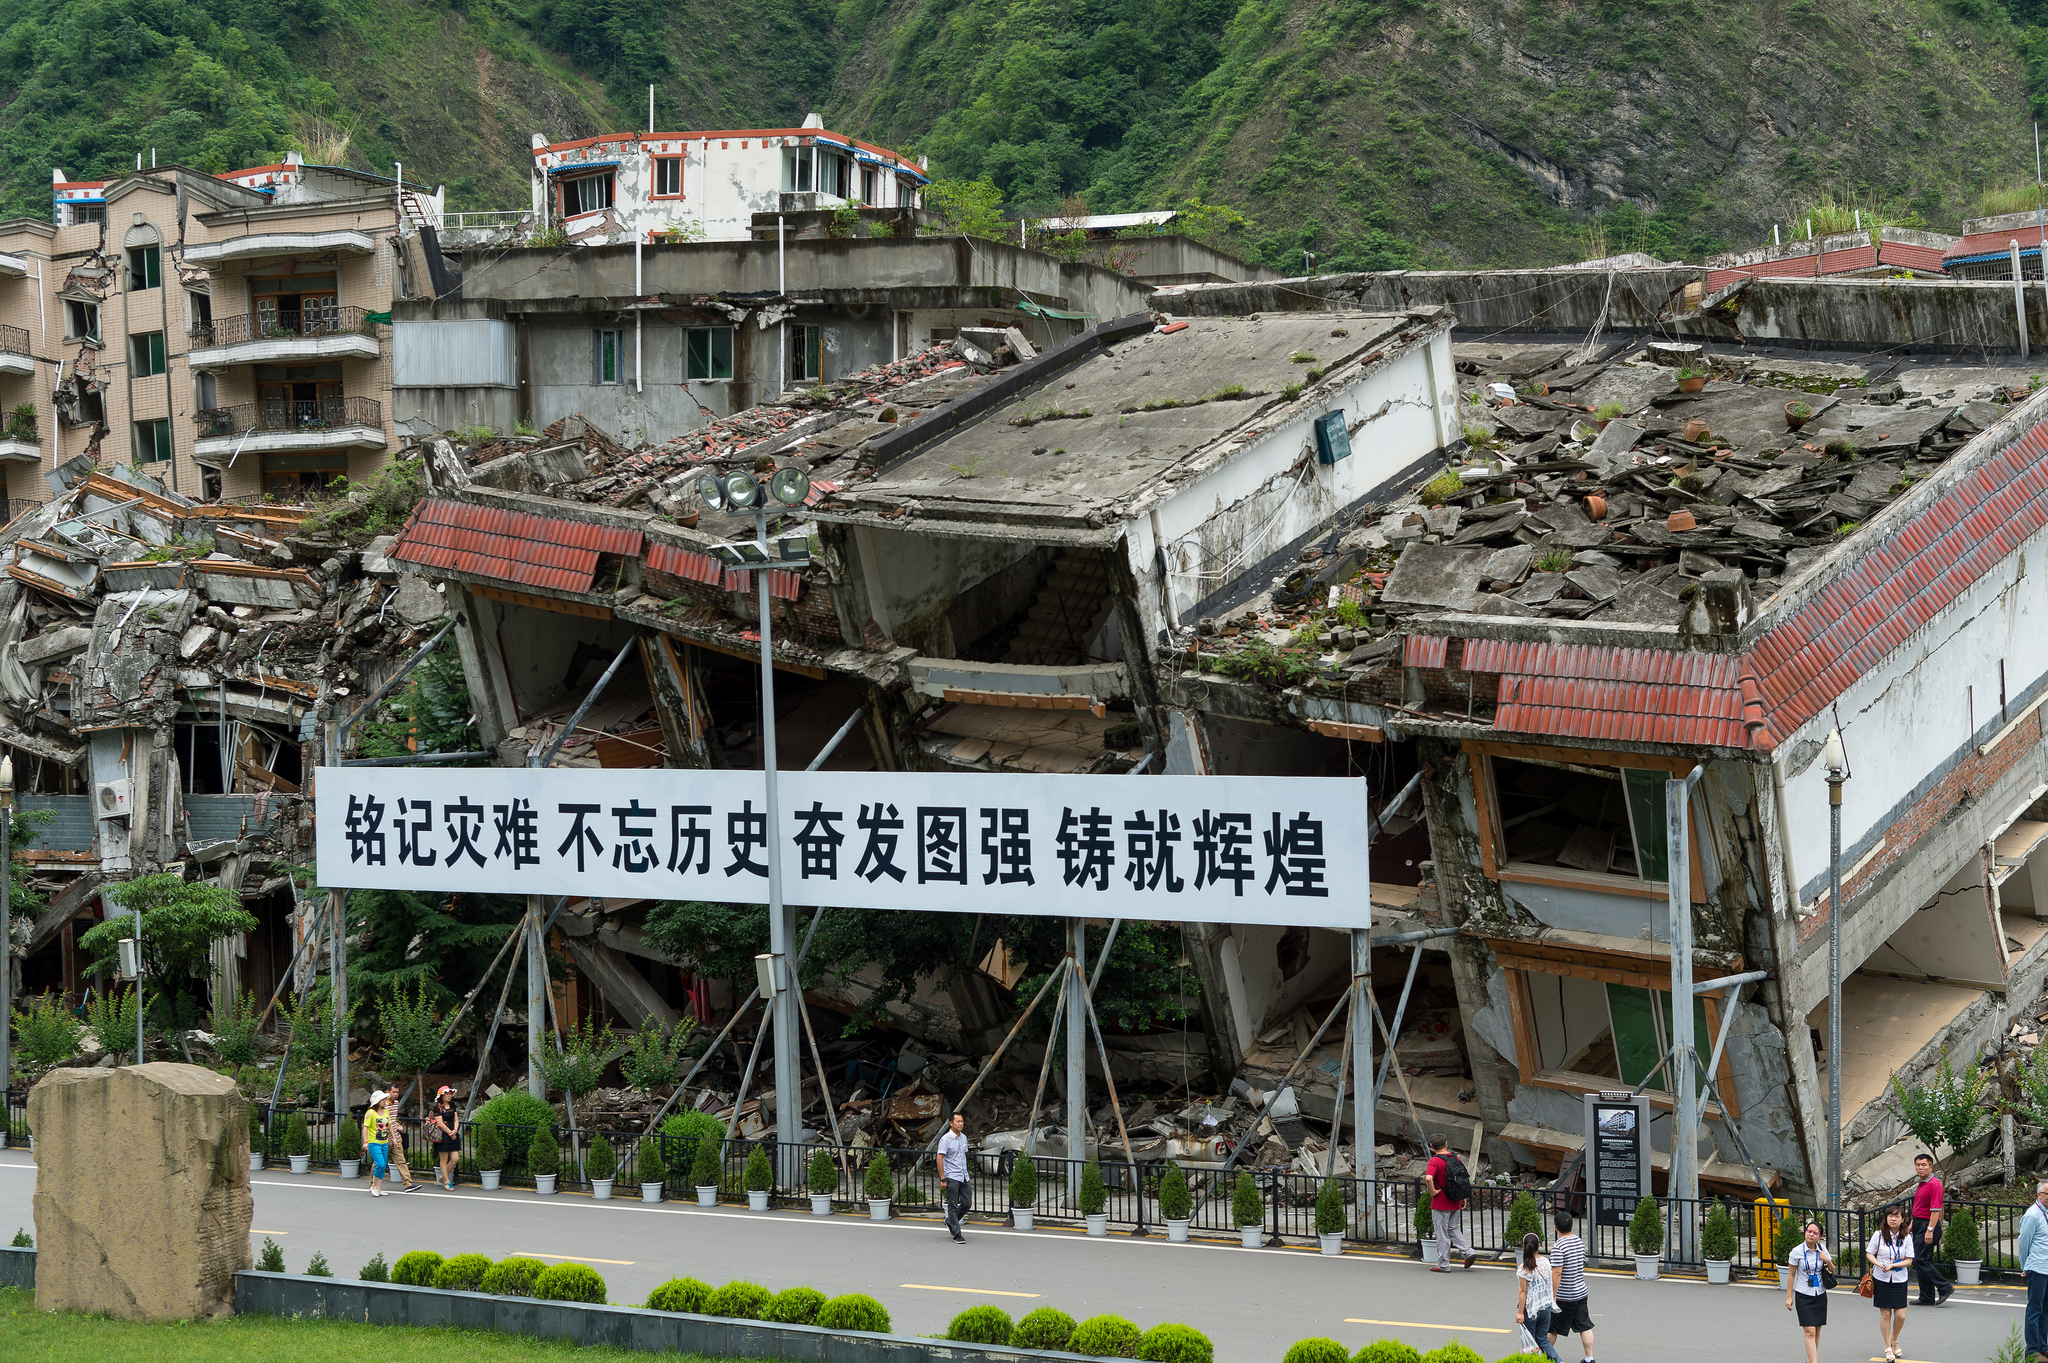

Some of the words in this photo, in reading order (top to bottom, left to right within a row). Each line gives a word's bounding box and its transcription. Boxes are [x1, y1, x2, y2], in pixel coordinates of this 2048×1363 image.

[345, 794, 541, 871] 铭记灾难
[558, 798, 769, 878] 不忘历史
[793, 801, 1036, 886] 奋发图强
[1056, 806, 1329, 897] 铸就辉煌
